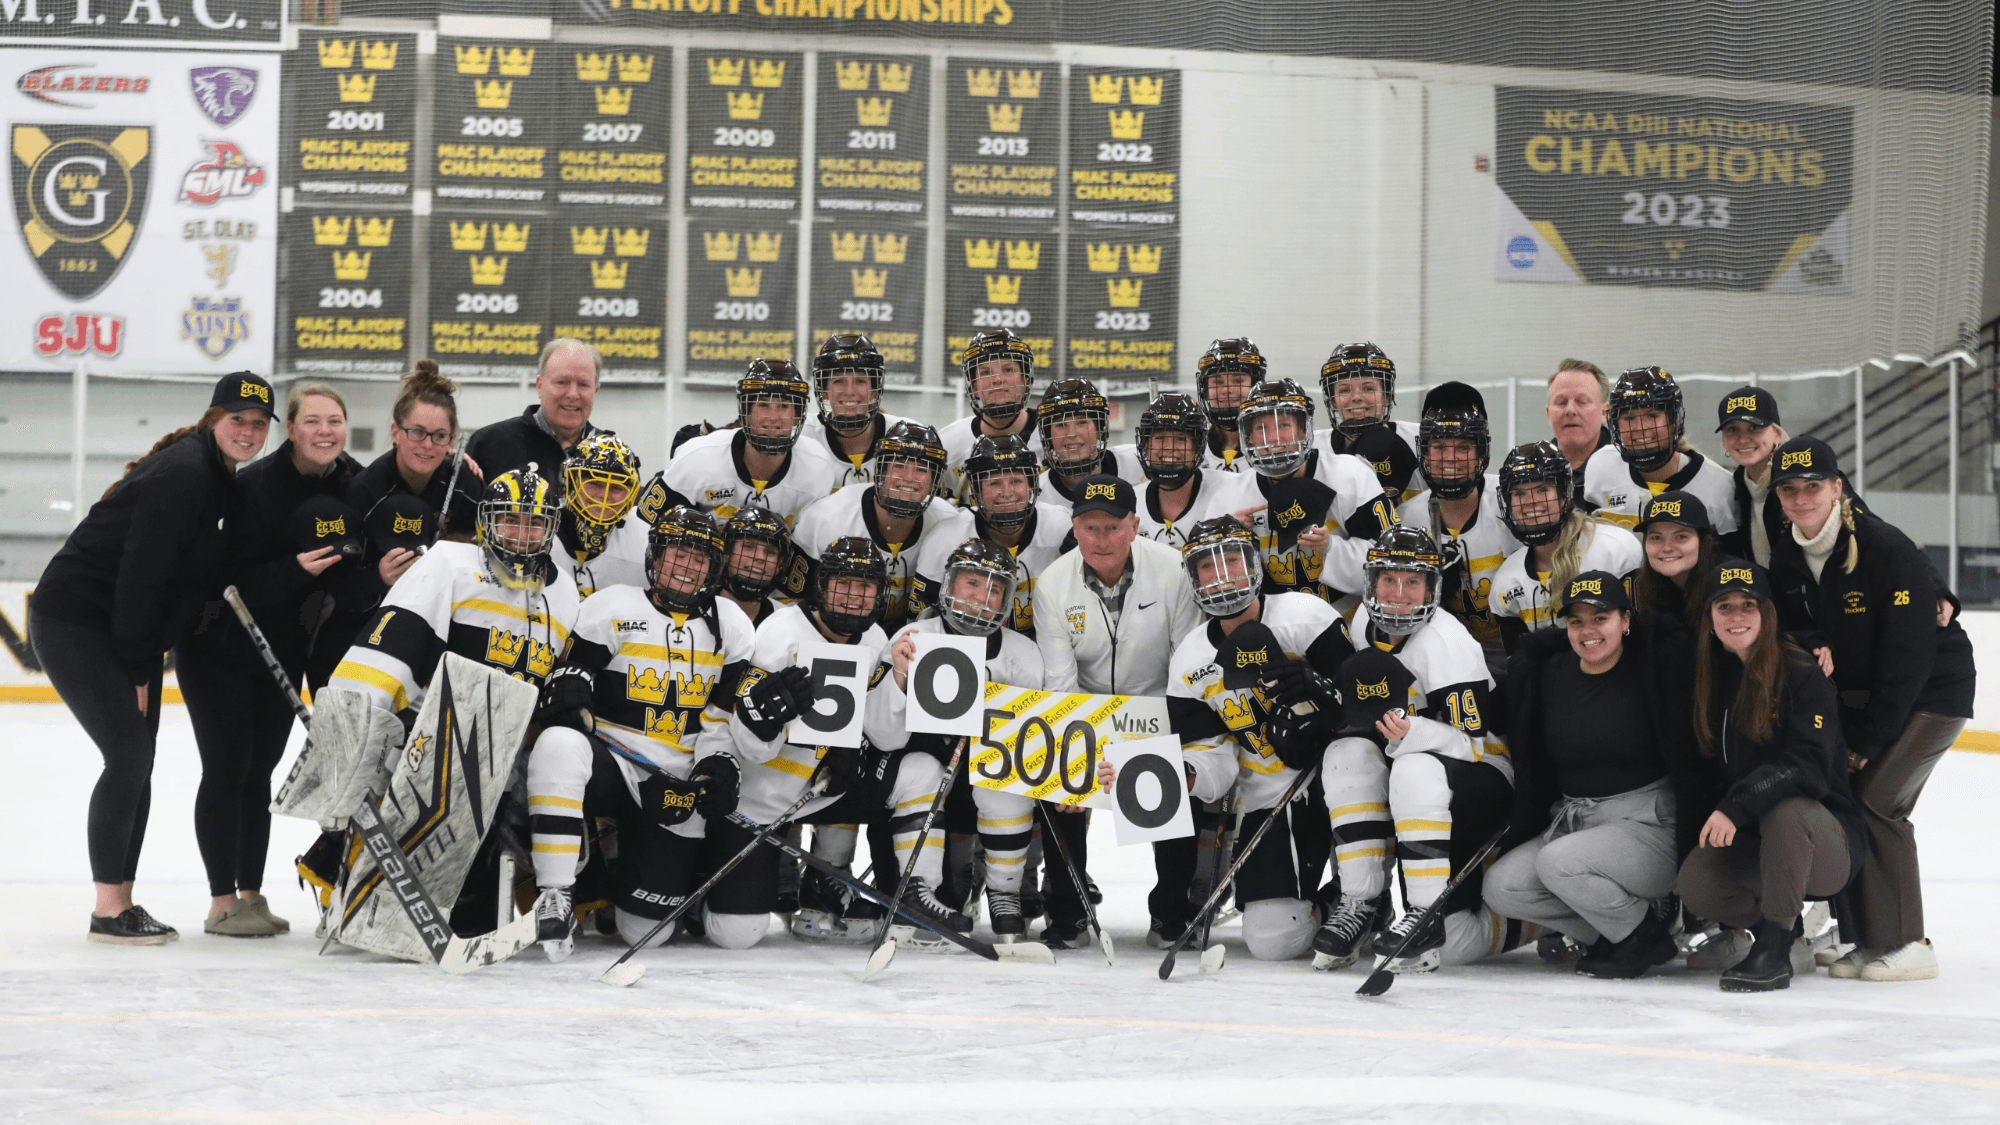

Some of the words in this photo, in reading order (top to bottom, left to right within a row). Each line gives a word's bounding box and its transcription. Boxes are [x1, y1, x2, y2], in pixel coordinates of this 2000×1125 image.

[24, 76, 149, 92] BLAZERS
[326, 110, 384, 131] 2001
[461, 117, 523, 138] 2005
[1544, 109, 1619, 132] NCAA
[1677, 118, 1806, 142] NATIONAL
[583, 123, 643, 143] 2007
[713, 127, 775, 148] 2009
[847, 130, 897, 150] 2011
[977, 137, 1029, 156] 2013
[1097, 143, 1153, 163] 2022
[301, 155, 407, 172] CHAMPIONS
[438, 161, 543, 179] CHAMPIONS
[1524, 135, 1826, 187] CHAMPIONS
[560, 166, 663, 184] CHAMPIONS
[692, 171, 795, 188] CHAMPIONS
[821, 173, 921, 191] CHAMPIONS
[44, 156, 111, 226] G
[953, 180, 1052, 197] CHAMPIONS
[1075, 185, 1174, 202] CHAMPIONS
[1622, 192, 1731, 228] 2023
[59, 259, 98, 272] 1862
[319, 288, 383, 309] 2004
[456, 293, 519, 314] 2006
[577, 297, 639, 317] 2008
[714, 302, 769, 321] 2010
[840, 302, 893, 321] 2012
[972, 308, 1031, 327] 2020
[1095, 311, 1151, 331] 2023
[37, 314, 123, 355] SJU
[297, 333, 402, 350] CHAMPIONS
[434, 337, 539, 355] CHAMPIONS
[690, 345, 793, 361] CHAMPIONS
[1073, 354, 1171, 371] CHAMPIONS
[1893, 590, 1910, 605] 26
[1844, 606, 1866, 614] Hockey
[368, 611, 396, 645] 1
[616, 621, 647, 631] MIAC
[800, 657, 857, 733] 5
[1446, 689, 1482, 731] 19
[1112, 712, 1160, 734] WINS
[978, 708, 1097, 795] 500
